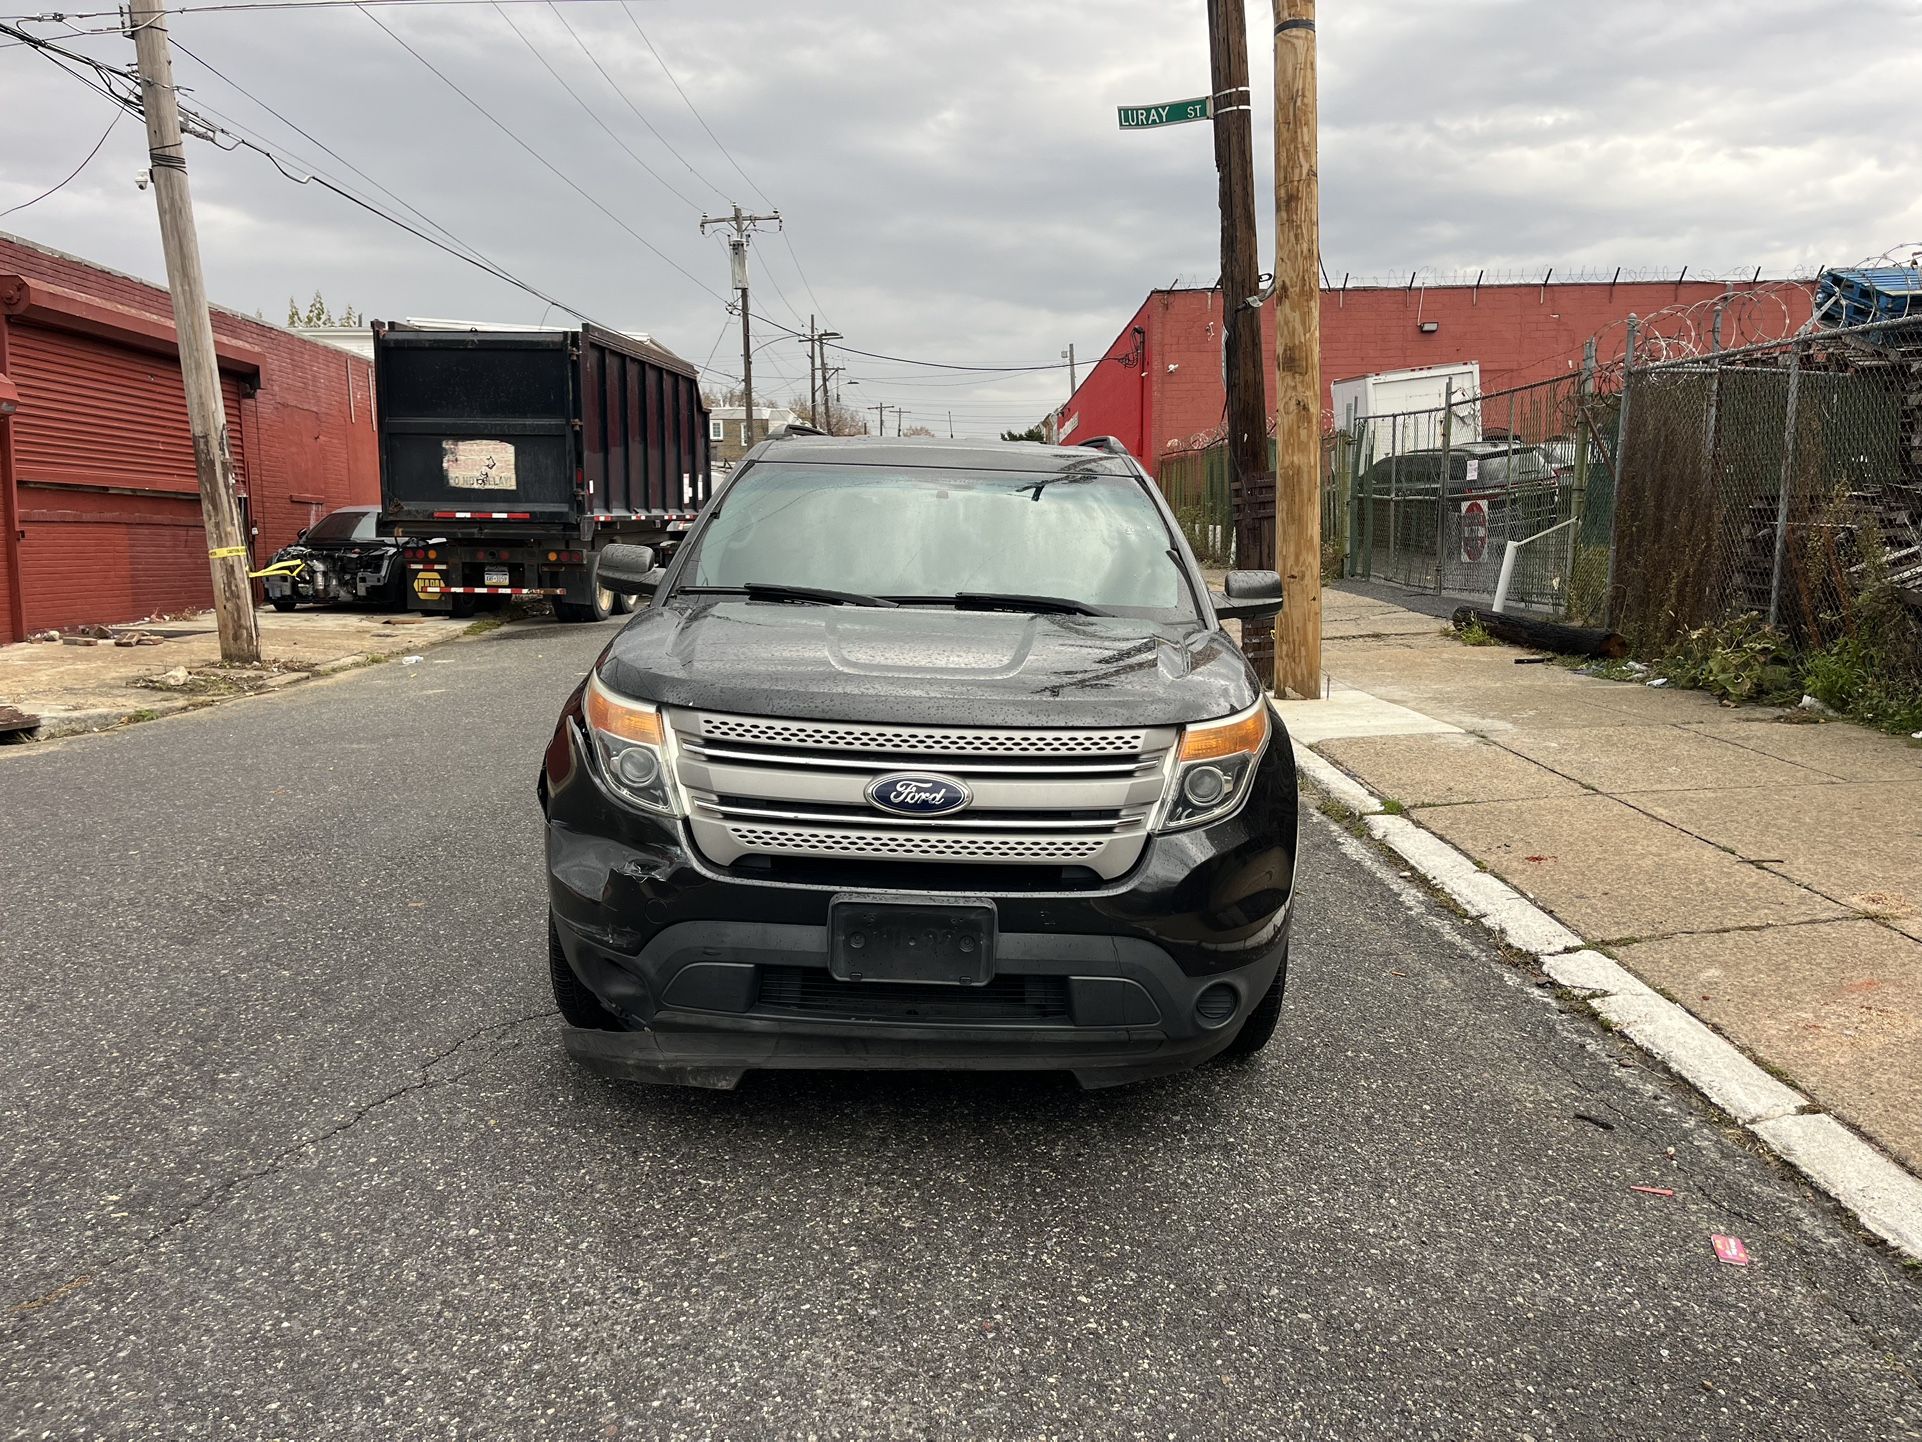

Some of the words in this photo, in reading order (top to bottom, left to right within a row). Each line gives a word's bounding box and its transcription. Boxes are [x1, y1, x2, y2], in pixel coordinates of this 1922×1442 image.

[1120, 106, 1170, 126] LURAY
[1187, 105, 1202, 118] ST
[890, 780, 946, 805] Ford
